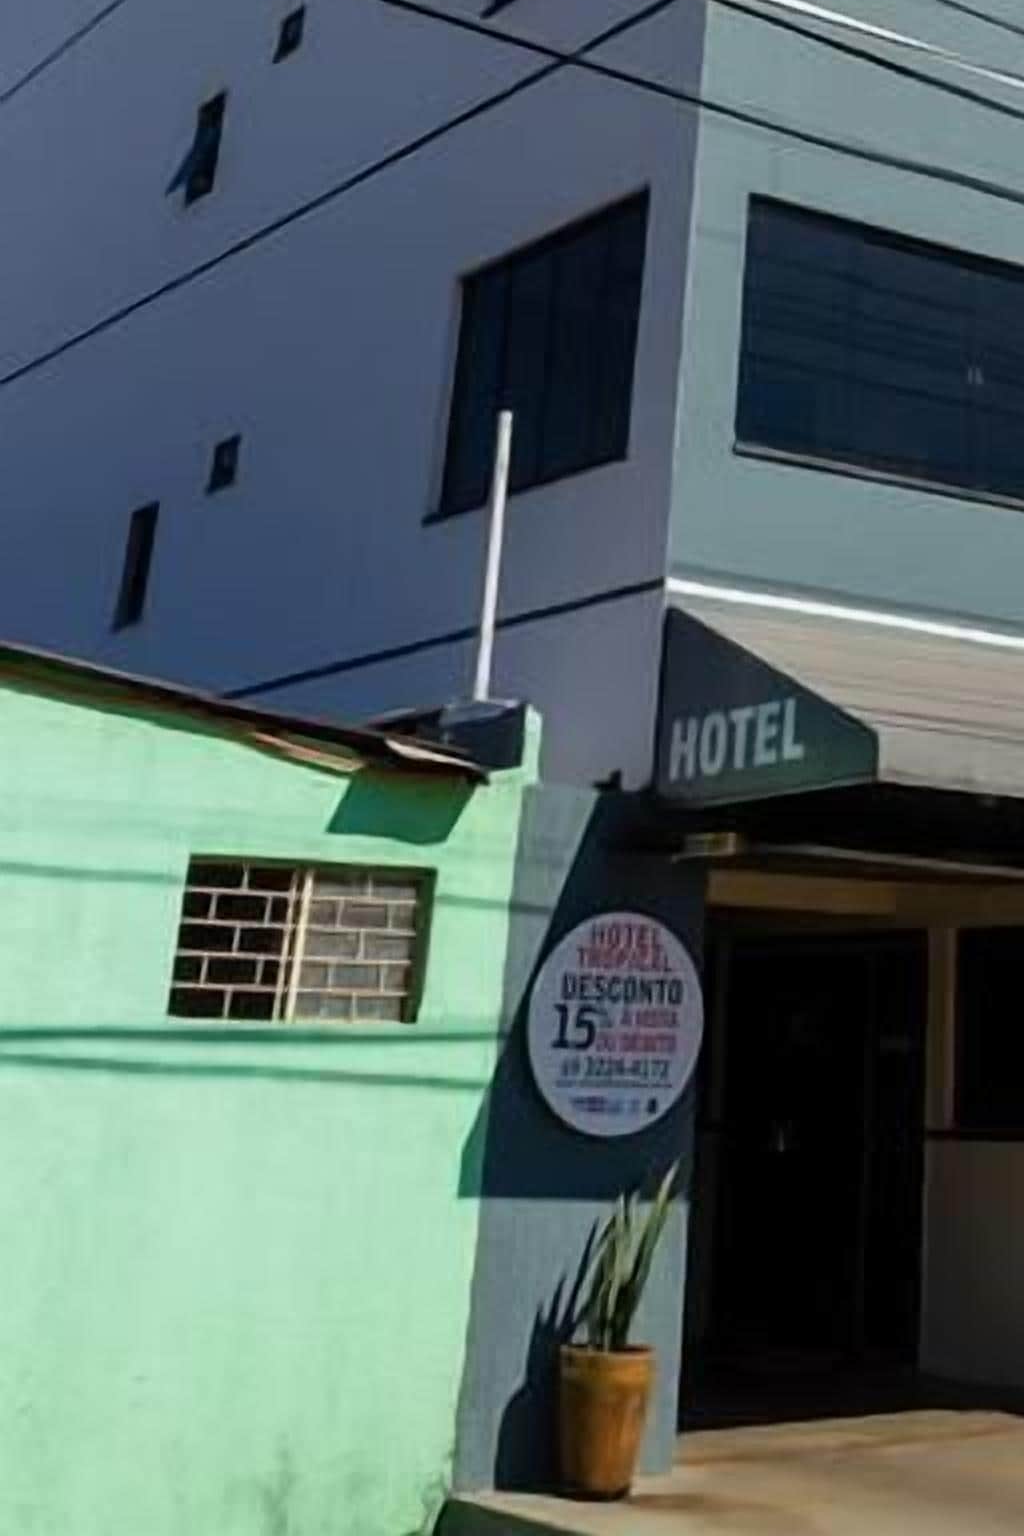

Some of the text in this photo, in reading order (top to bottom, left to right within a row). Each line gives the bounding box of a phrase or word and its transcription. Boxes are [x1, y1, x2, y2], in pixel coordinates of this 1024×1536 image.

[669, 696, 805, 783] HOTEL
[591, 921, 661, 948] HOTEL
[576, 945, 673, 972] TROPICAL
[561, 973, 684, 1005] DESCONTO
